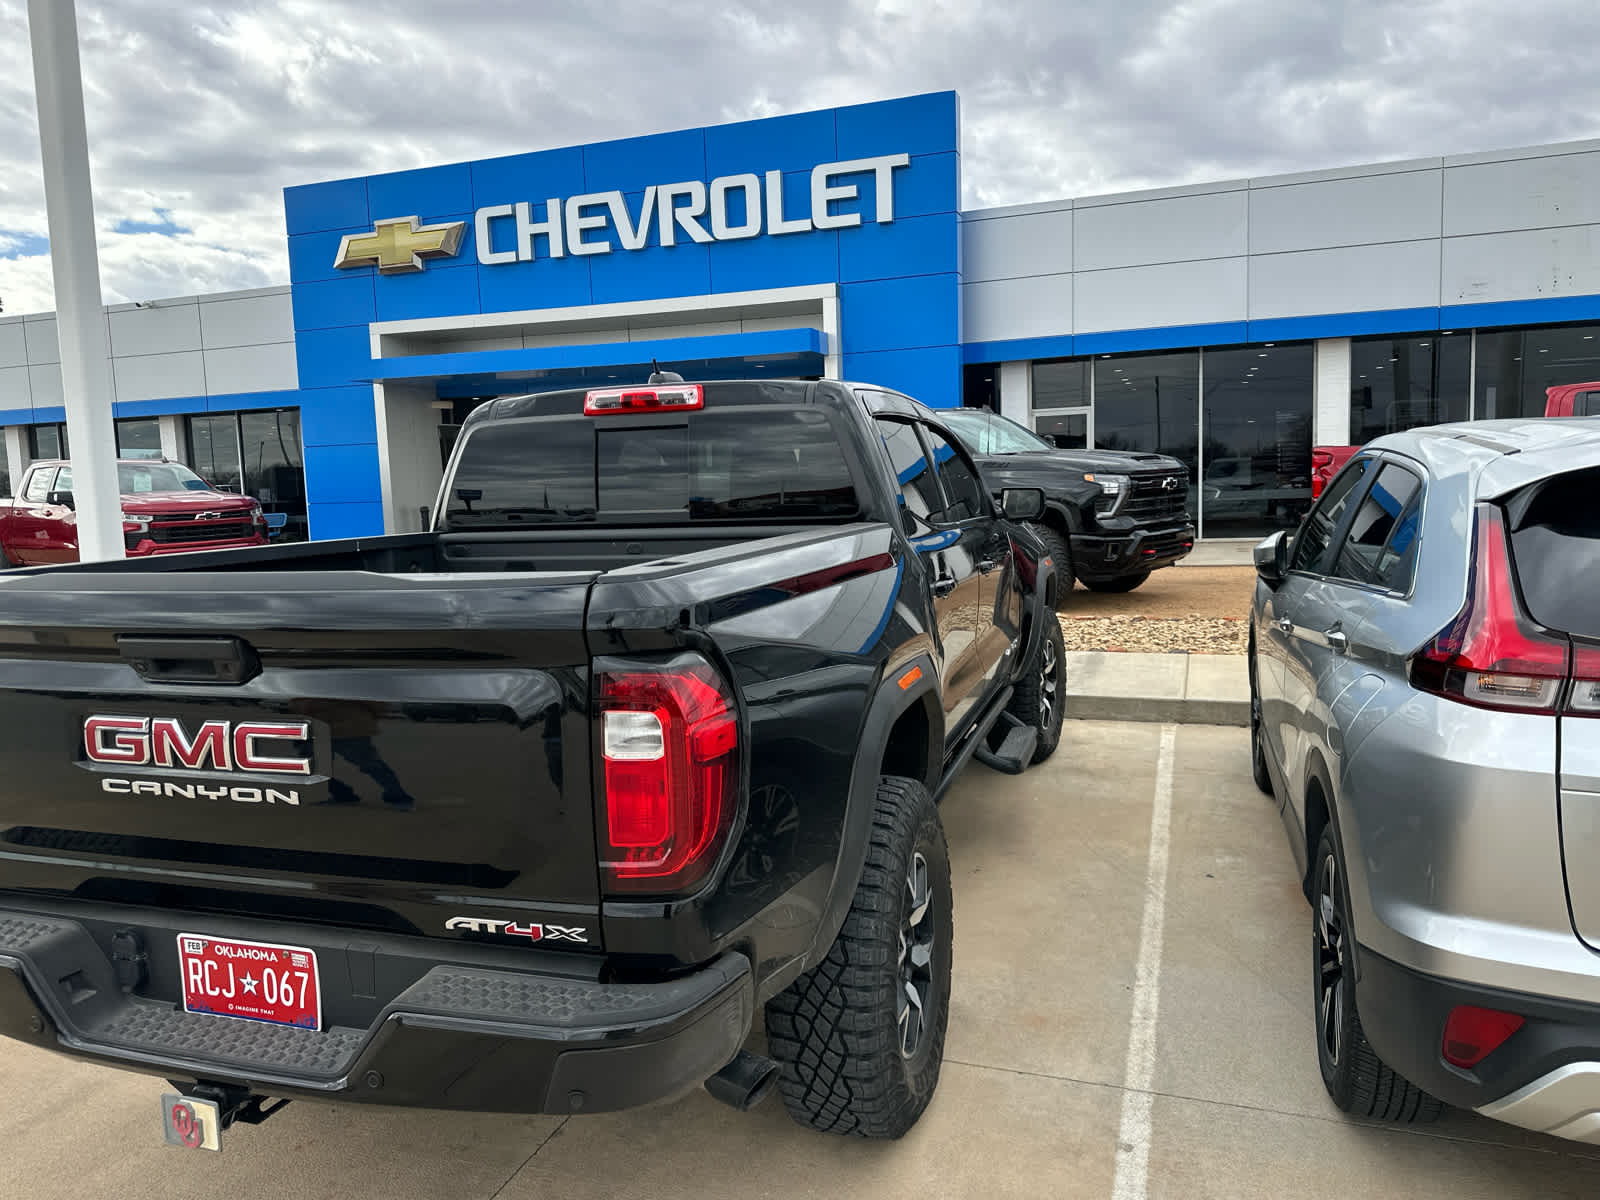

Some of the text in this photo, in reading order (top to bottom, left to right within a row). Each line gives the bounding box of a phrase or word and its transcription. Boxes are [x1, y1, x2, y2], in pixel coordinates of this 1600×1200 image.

[473, 152, 910, 265] CHEVROLET
[84, 715, 311, 775] GMC
[102, 778, 299, 806] CANYON
[445, 916, 588, 942] AT4X
[187, 941, 201, 950] FEB
[214, 945, 278, 962] OKLAHOMA
[188, 958, 309, 1009] RCJ 067
[235, 1005, 274, 1016] IMAGINE THAT
